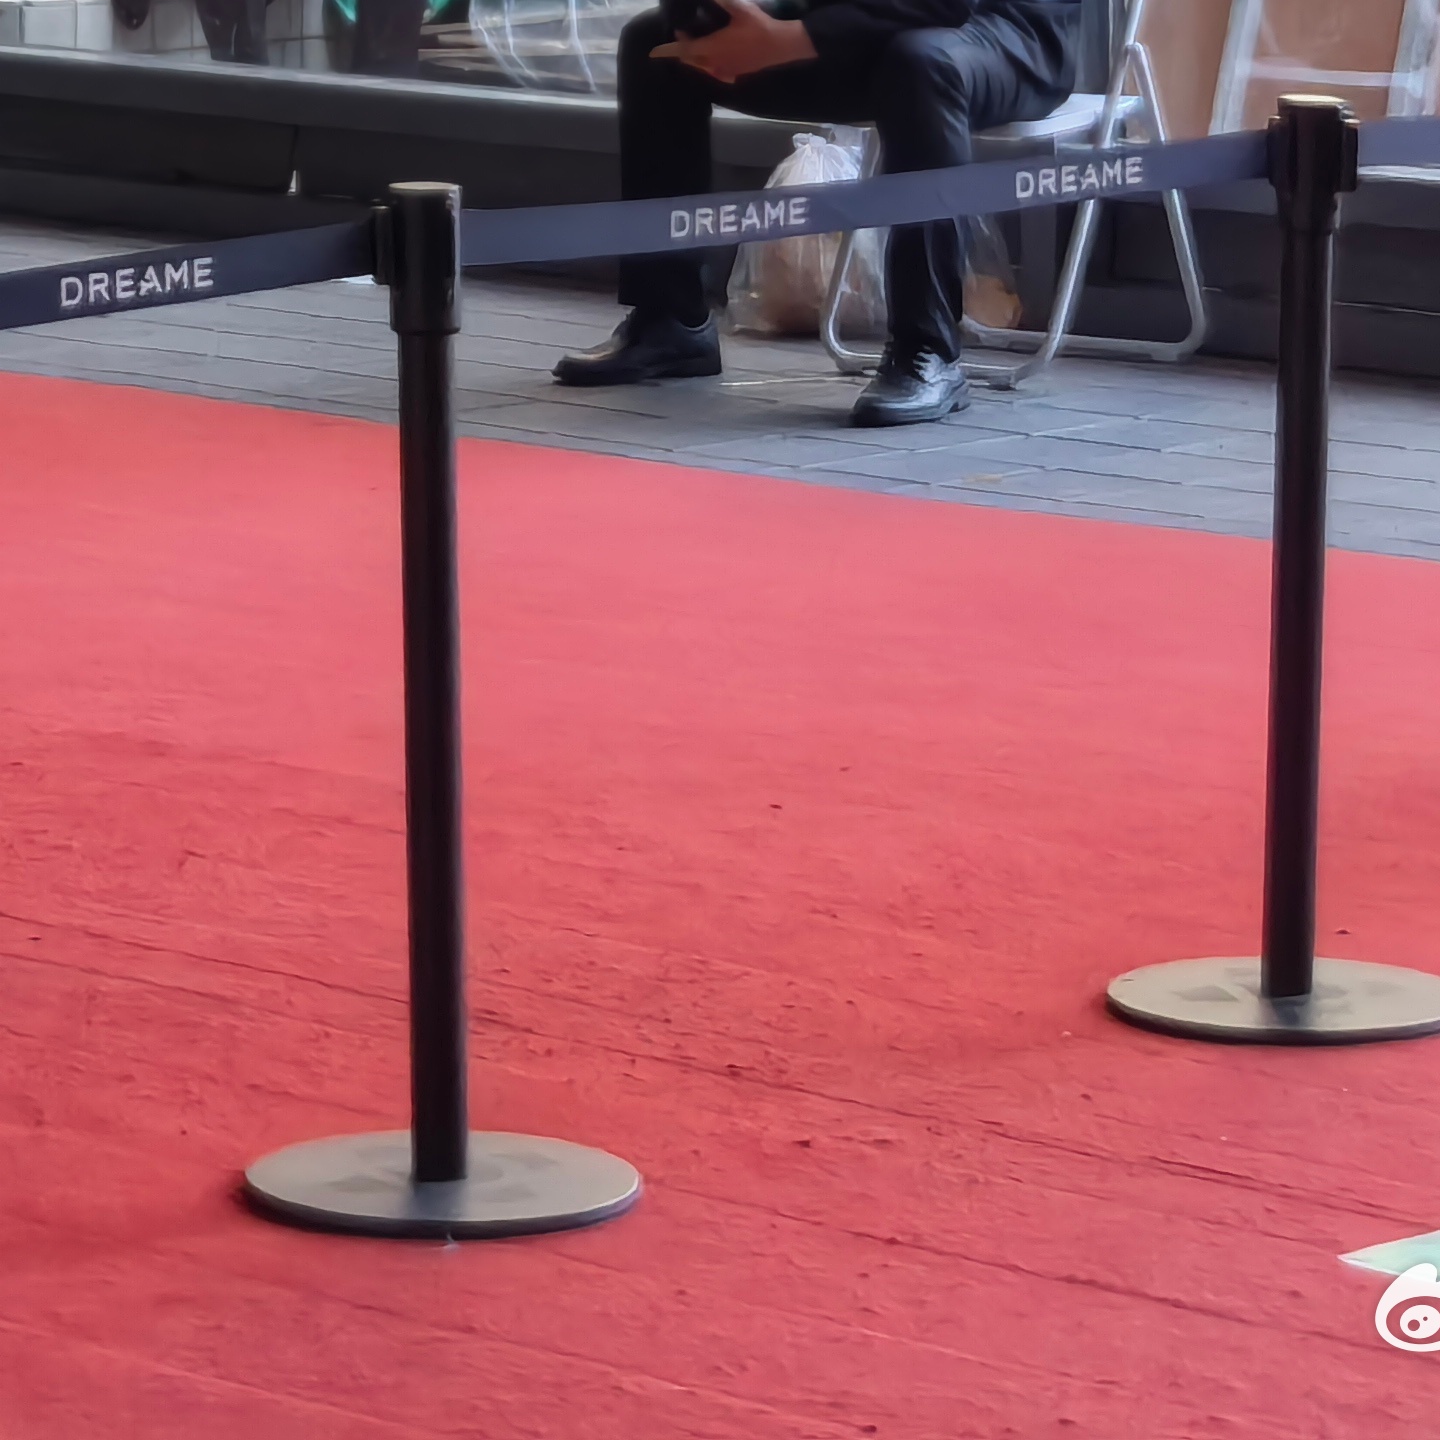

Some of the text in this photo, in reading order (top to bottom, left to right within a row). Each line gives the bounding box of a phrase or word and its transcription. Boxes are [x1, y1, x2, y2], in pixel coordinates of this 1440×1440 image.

[669, 156, 1143, 239] DREAME DREAME
[59, 255, 214, 307] DREAME
